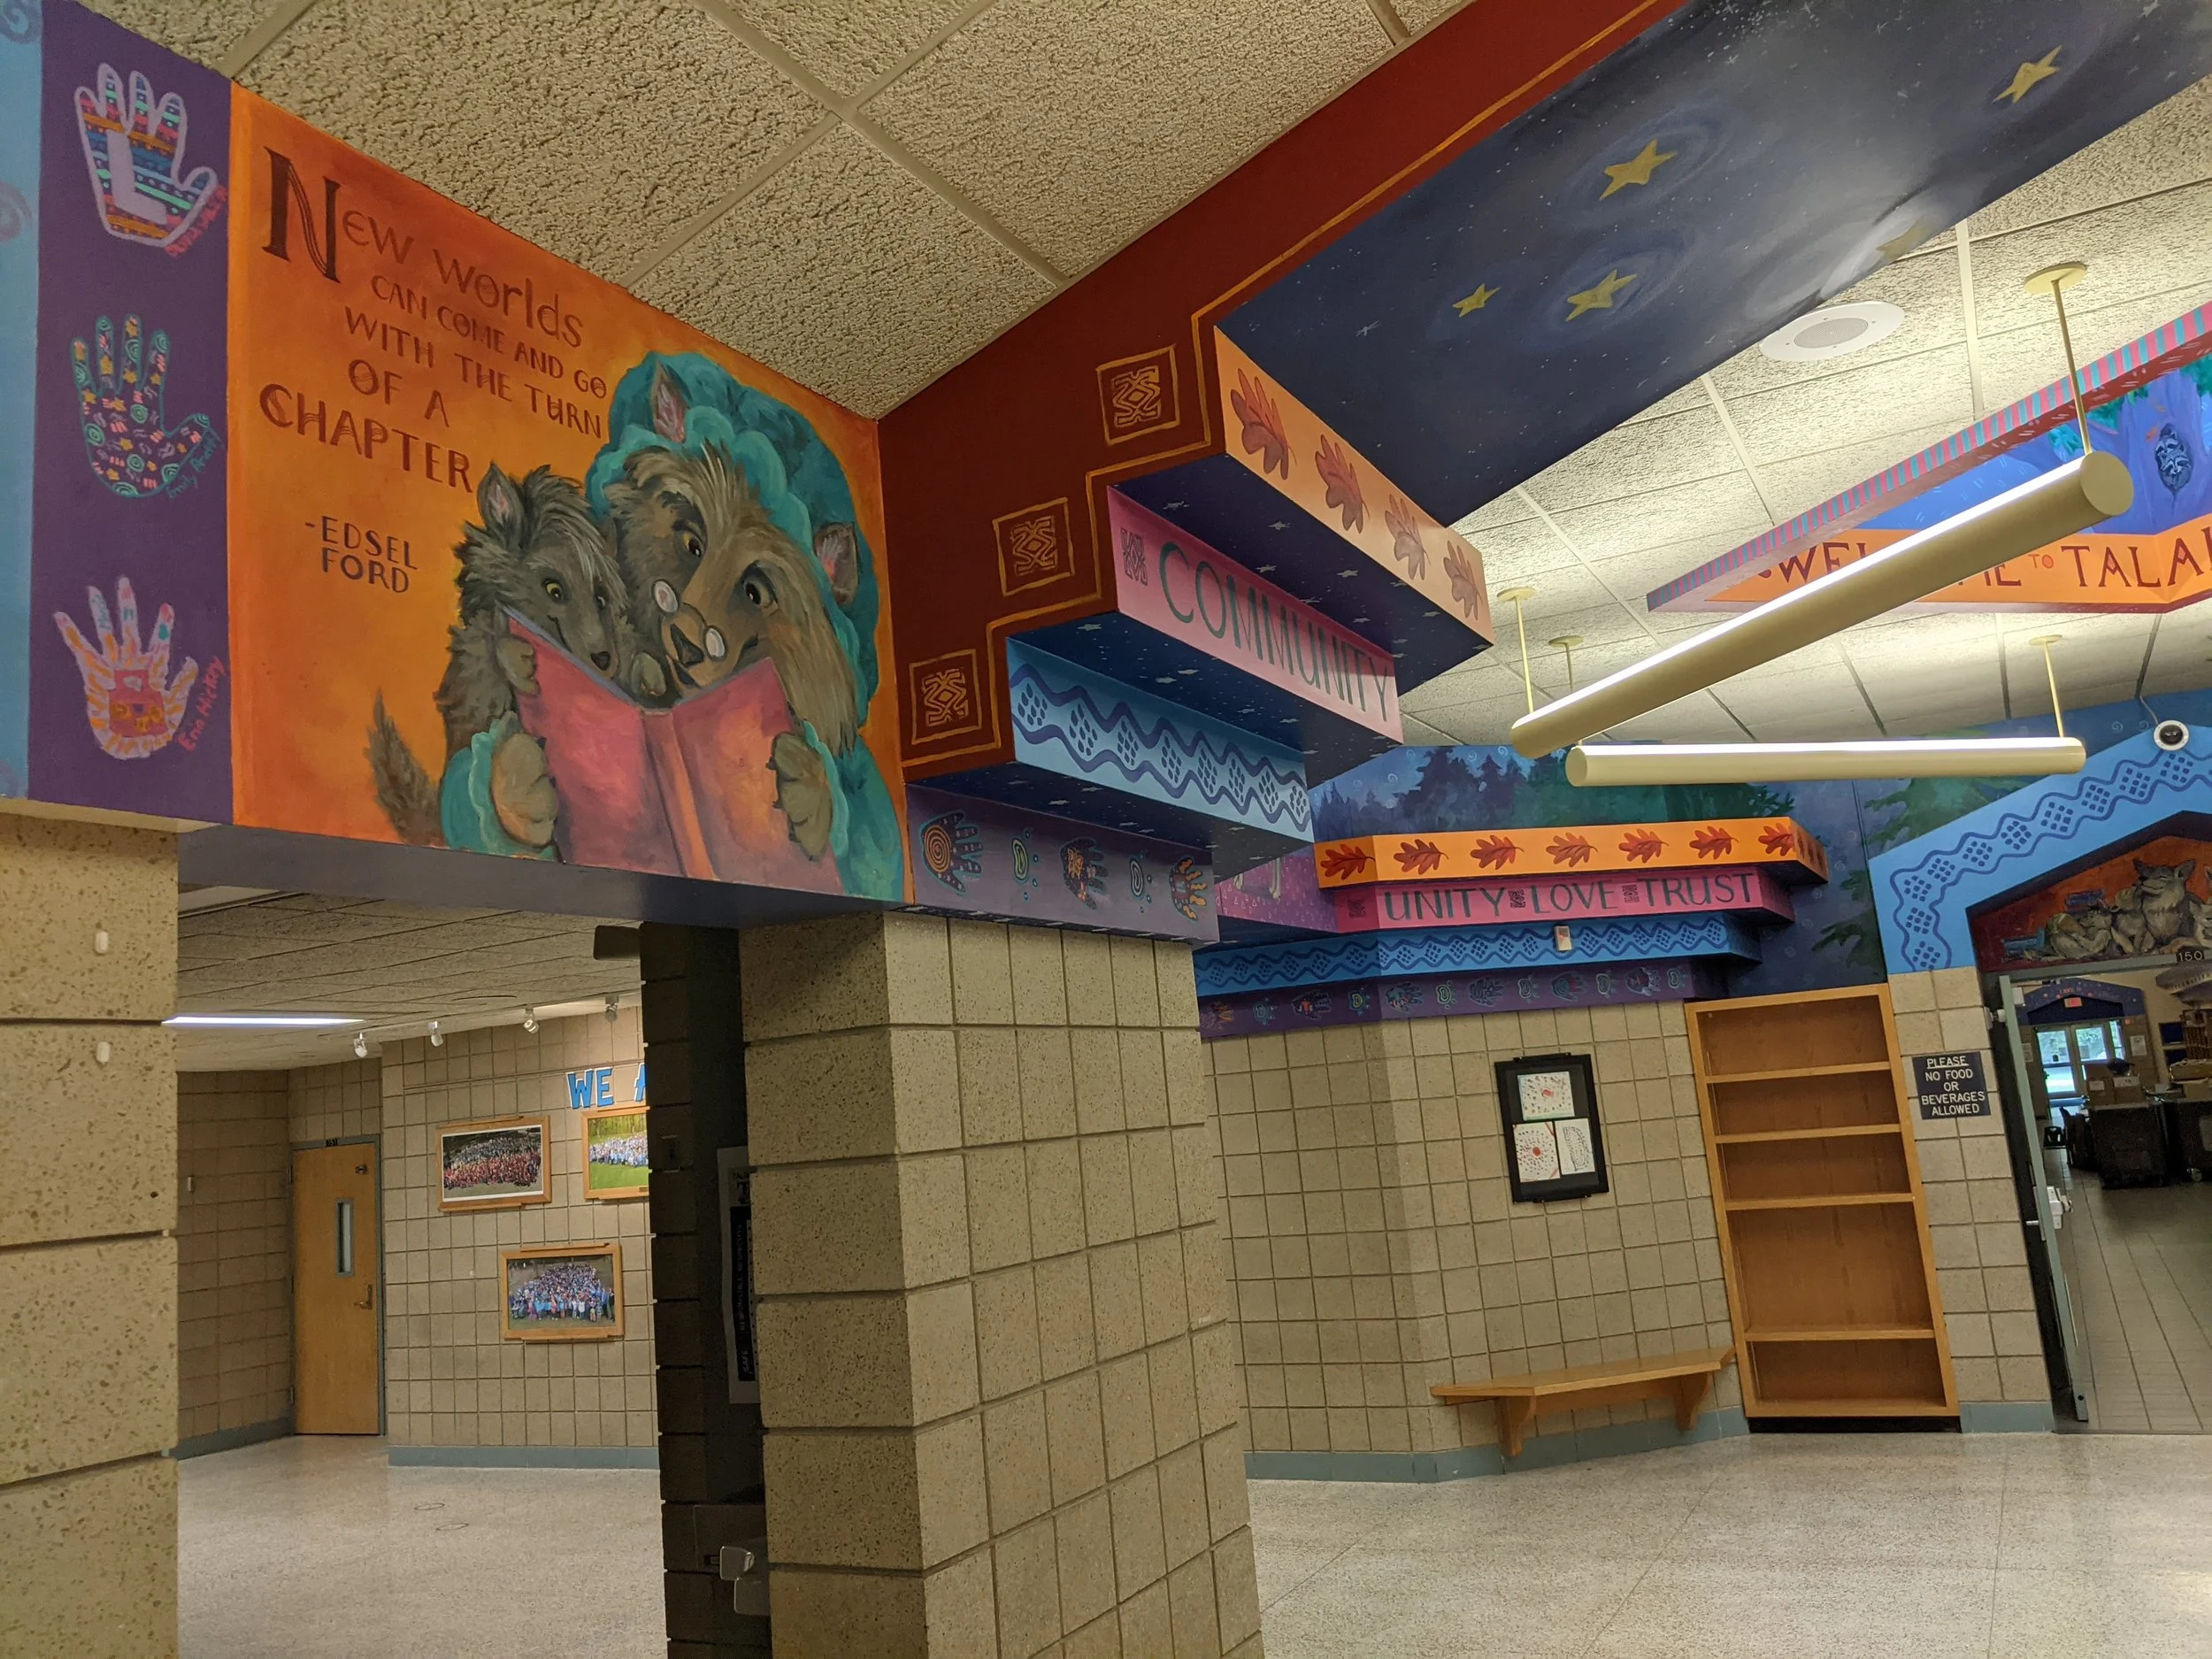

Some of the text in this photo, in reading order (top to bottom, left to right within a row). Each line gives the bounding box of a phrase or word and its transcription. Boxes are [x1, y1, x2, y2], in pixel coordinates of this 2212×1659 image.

[372, 274, 607, 399] CAN COME AND GO
[345, 306, 603, 439] WITH THE TURN
[348, 358, 449, 427] OF A
[259, 383, 472, 493] CHAPTER
[321, 548, 410, 594] FORD
[2027, 554, 2055, 570] TO
[2060, 526, 2212, 588] TALA
[1158, 541, 1389, 723] COMMUNITY
[1384, 872, 1755, 921] UNITY LOVE TRUST
[2177, 950, 2203, 963] 150
[1924, 1068, 1973, 1082] NO FOOD
[1926, 1056, 1969, 1069] PLEASE
[566, 1066, 615, 1110] WE
[1921, 1091, 1985, 1105] BEVERAGES
[1932, 1103, 1979, 1116] ALLOWED
[1943, 1081, 1960, 1092] OR
